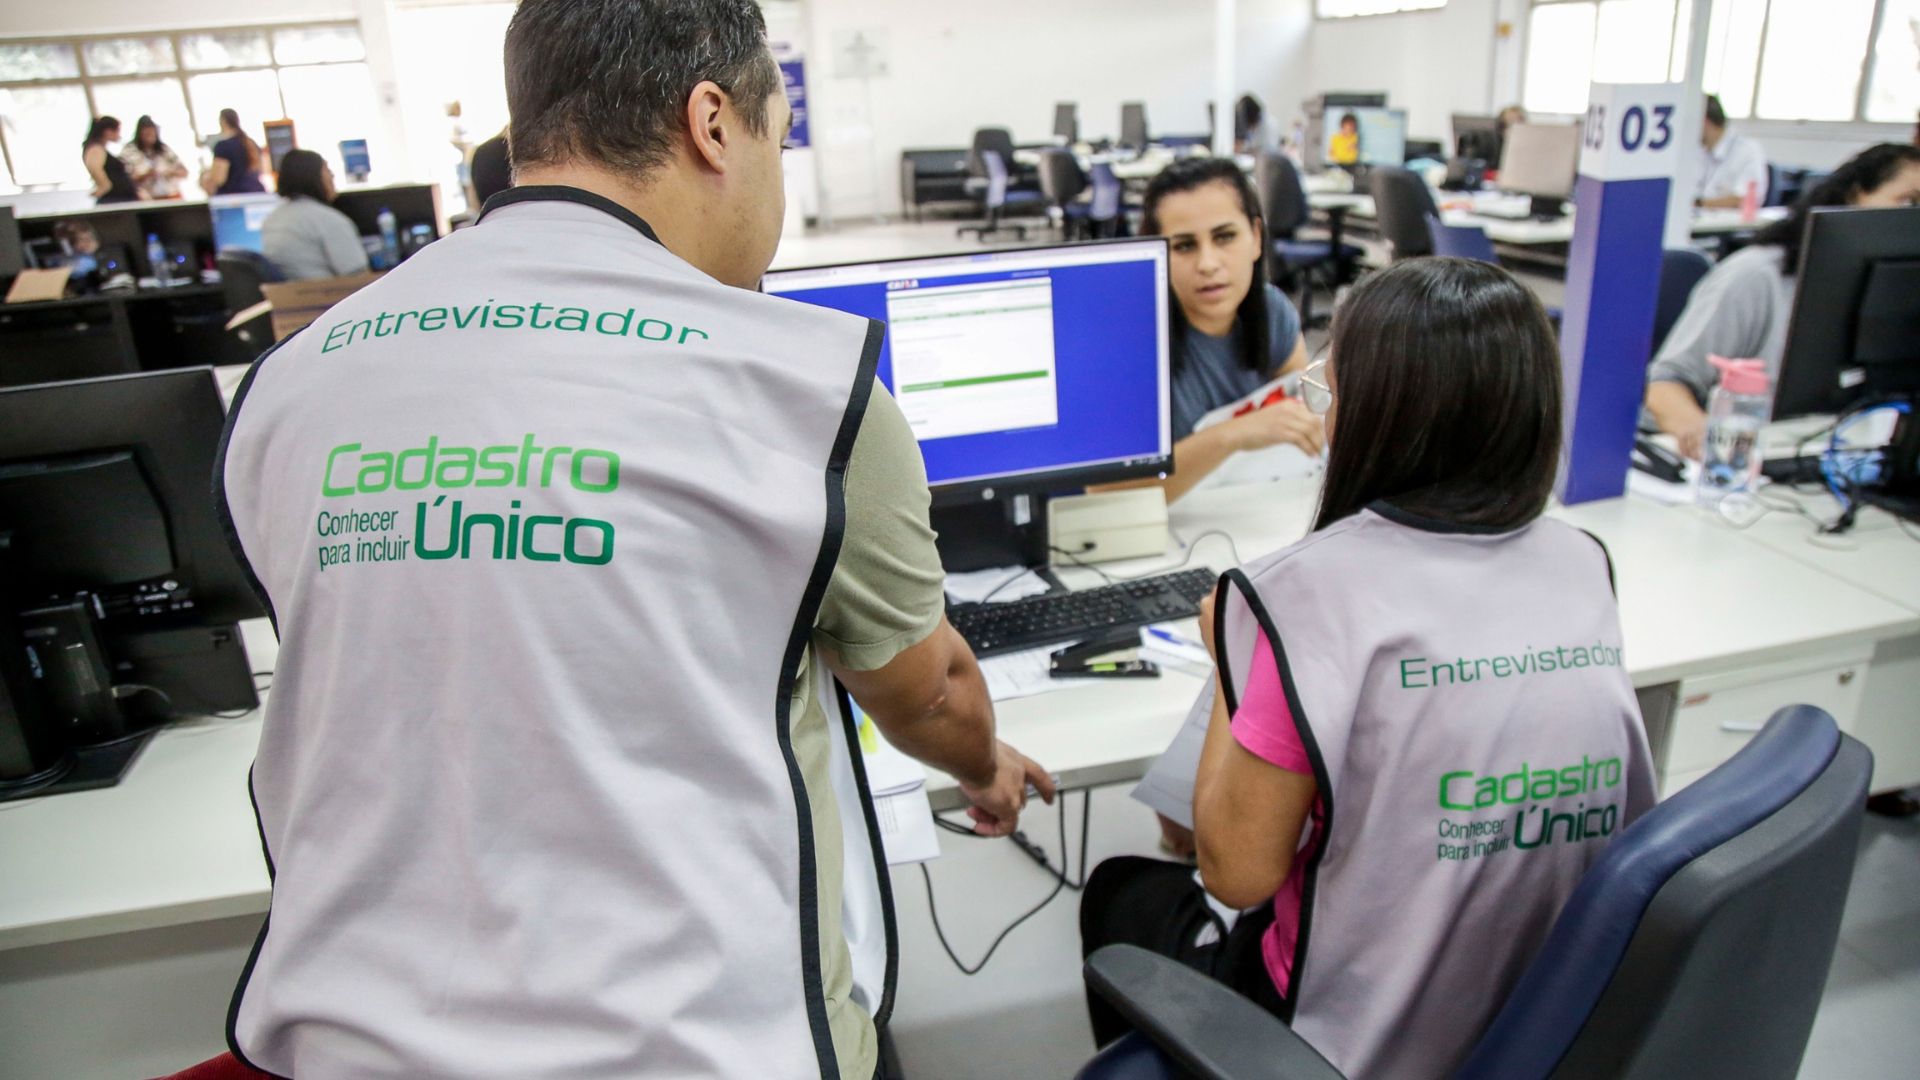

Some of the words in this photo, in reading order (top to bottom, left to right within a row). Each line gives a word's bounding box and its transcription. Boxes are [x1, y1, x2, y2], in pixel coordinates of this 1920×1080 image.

[1620, 105, 1675, 151] 03
[321, 298, 711, 353] Entrevistador
[321, 432, 622, 498] Cadastro
[316, 508, 400, 538] Conhecer
[413, 495, 616, 567] Único
[317, 538, 352, 572] para
[355, 534, 411, 563] incluir
[1400, 640, 1622, 690] Entrevistador
[1438, 754, 1623, 813] Cadastro
[1437, 817, 1507, 842] Conhecer
[1437, 842, 1471, 862] para
[1474, 835, 1511, 857] incluir
[1513, 802, 1618, 850] Único
